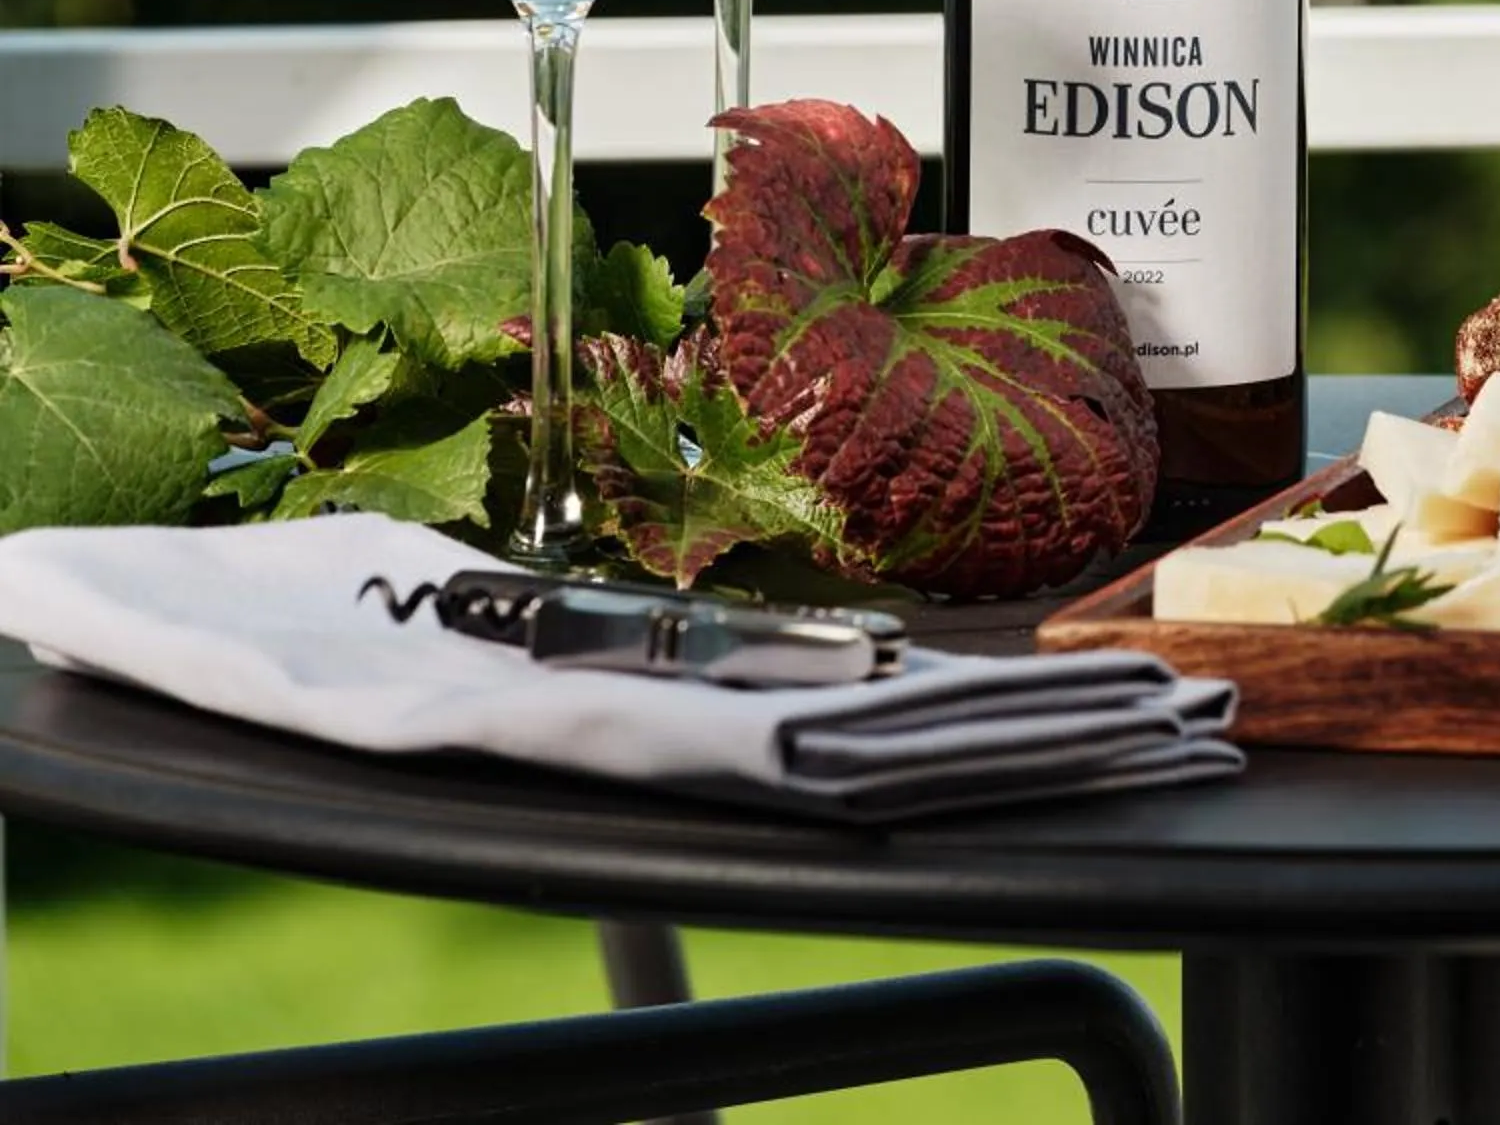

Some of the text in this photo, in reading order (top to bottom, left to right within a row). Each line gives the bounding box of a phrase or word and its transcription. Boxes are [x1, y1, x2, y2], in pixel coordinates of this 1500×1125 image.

[1089, 37, 1203, 67] WINNICA
[1023, 79, 1260, 139] EDISON
[1087, 198, 1201, 236] cuvée
[1123, 270, 1164, 284] 2022
[1132, 342, 1199, 357] dison.pl
